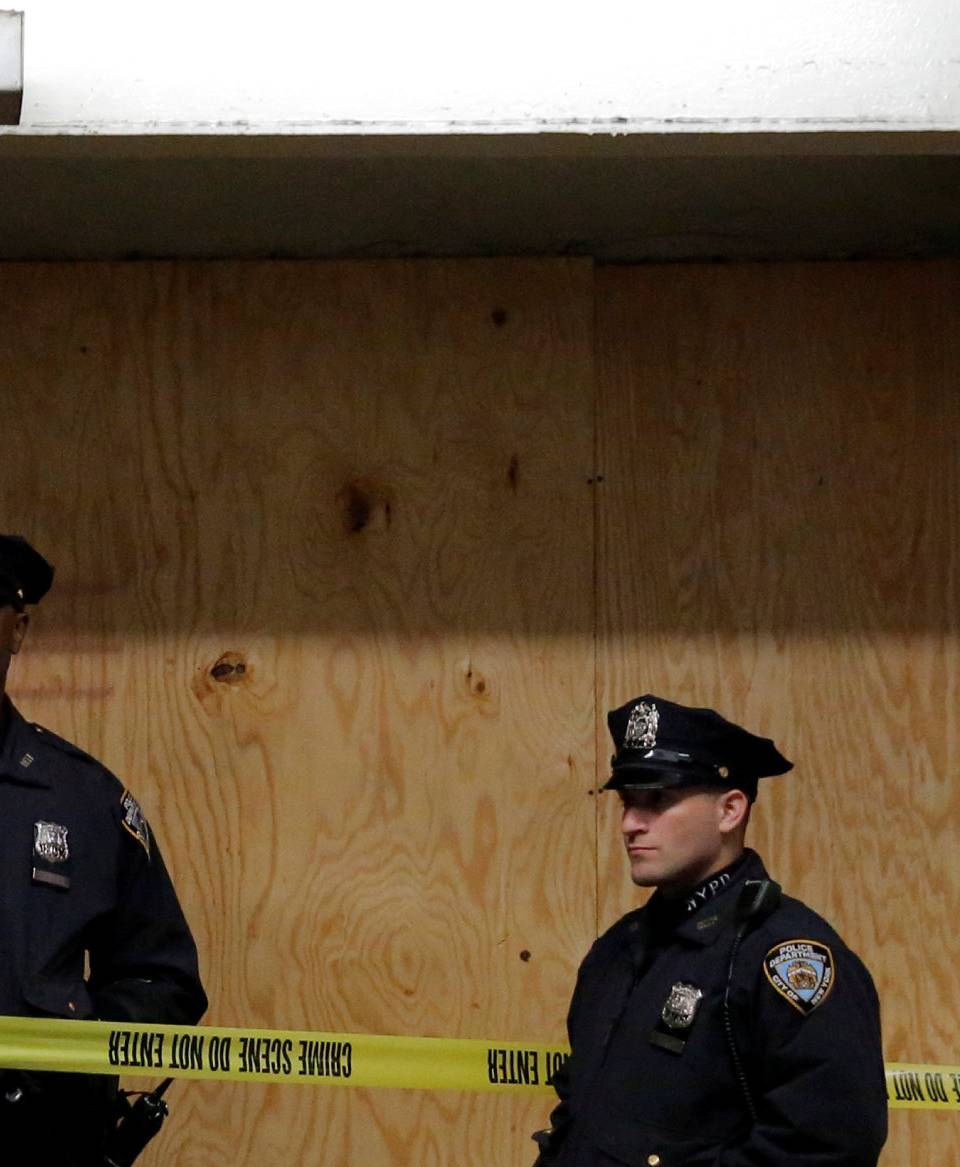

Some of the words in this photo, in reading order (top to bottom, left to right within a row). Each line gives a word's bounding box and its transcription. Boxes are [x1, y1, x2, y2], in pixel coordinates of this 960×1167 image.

[687, 873, 730, 911] NYPD
[779, 944, 814, 955] POLICE
[108, 1031, 164, 1067] ENTER
[169, 1034, 204, 1069] NOT
[208, 1036, 231, 1071] DO
[238, 1037, 292, 1074] SCENE
[298, 1040, 352, 1077] CRIME
[487, 1049, 539, 1085] ENTER
[545, 1052, 569, 1086] OT
[892, 1071, 925, 1101] NOT
[924, 1072, 948, 1102] DO
